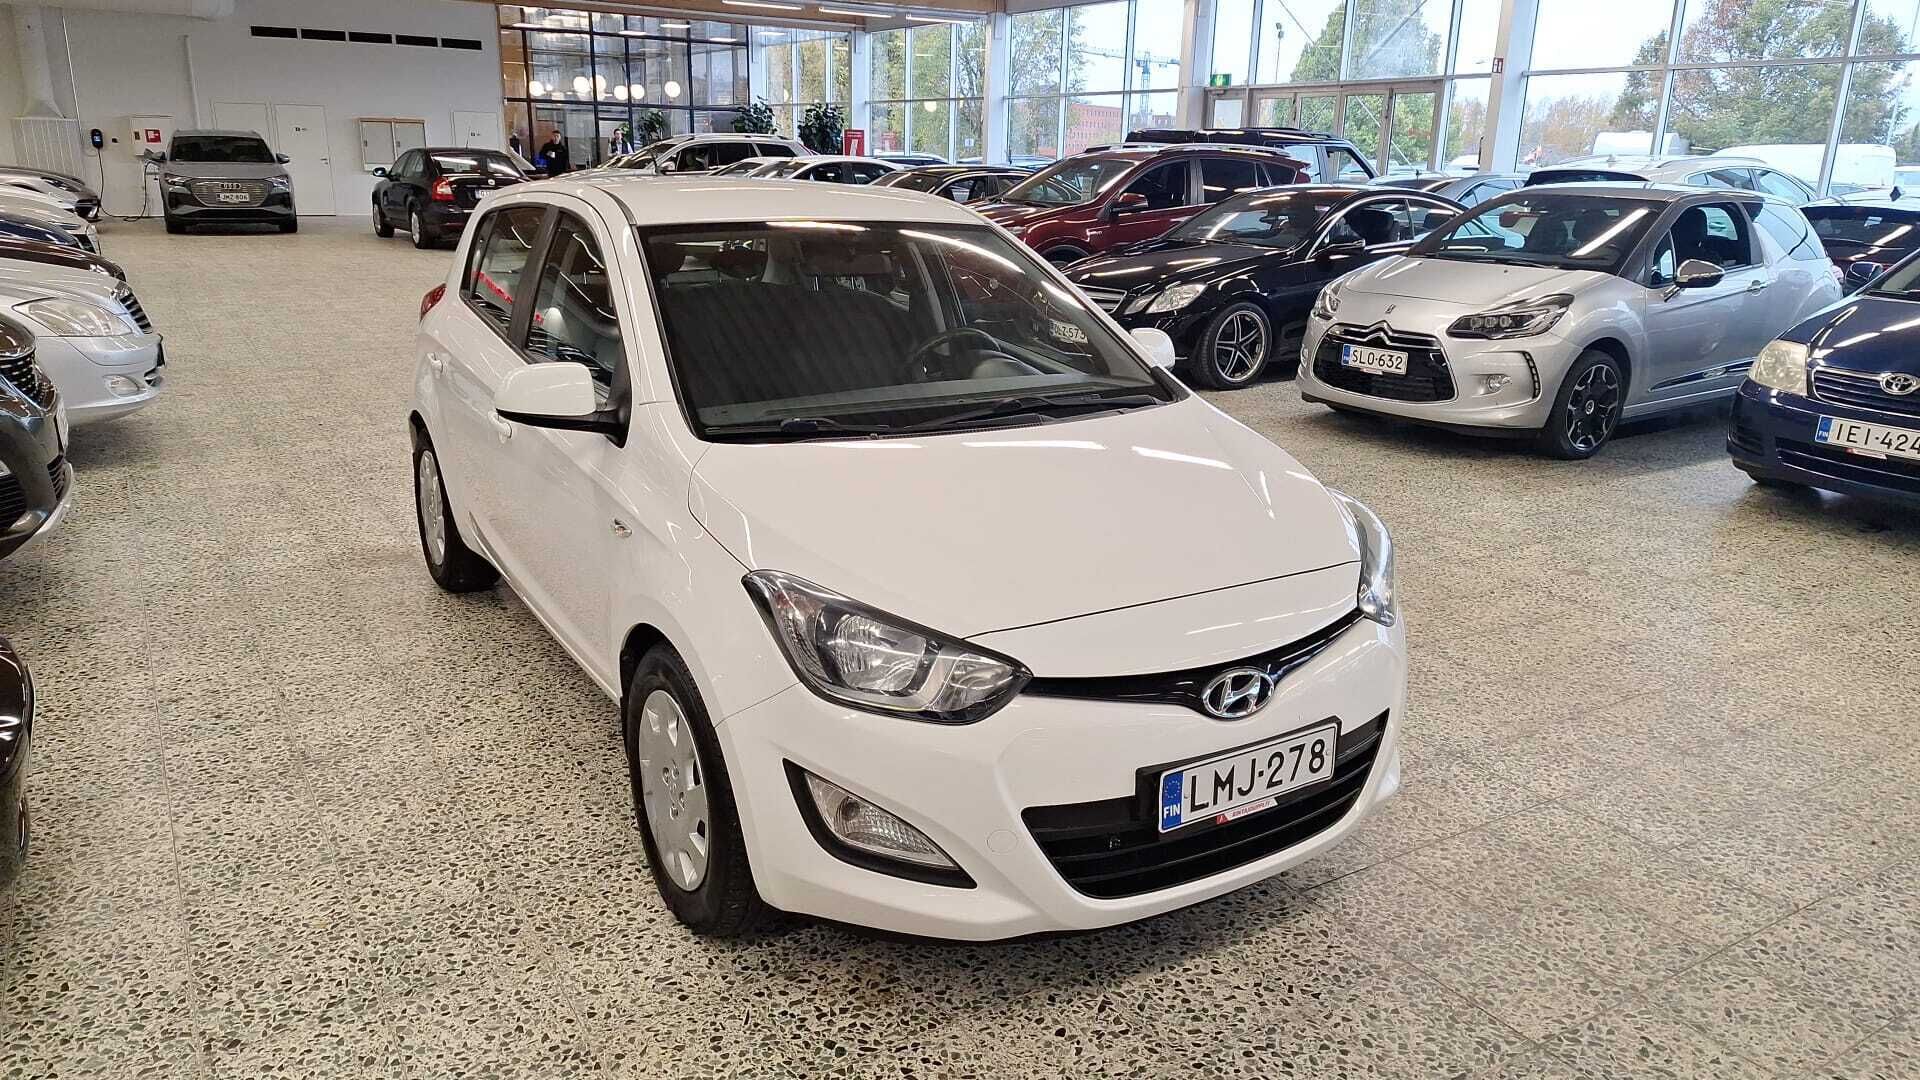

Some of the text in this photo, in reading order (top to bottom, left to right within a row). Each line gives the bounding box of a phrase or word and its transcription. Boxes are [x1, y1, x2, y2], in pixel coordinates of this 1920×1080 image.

[1351, 349, 1404, 370] SLO-632
[1836, 423, 1920, 455] IEI-424
[1163, 737, 1326, 819] FIN LMJ-278
